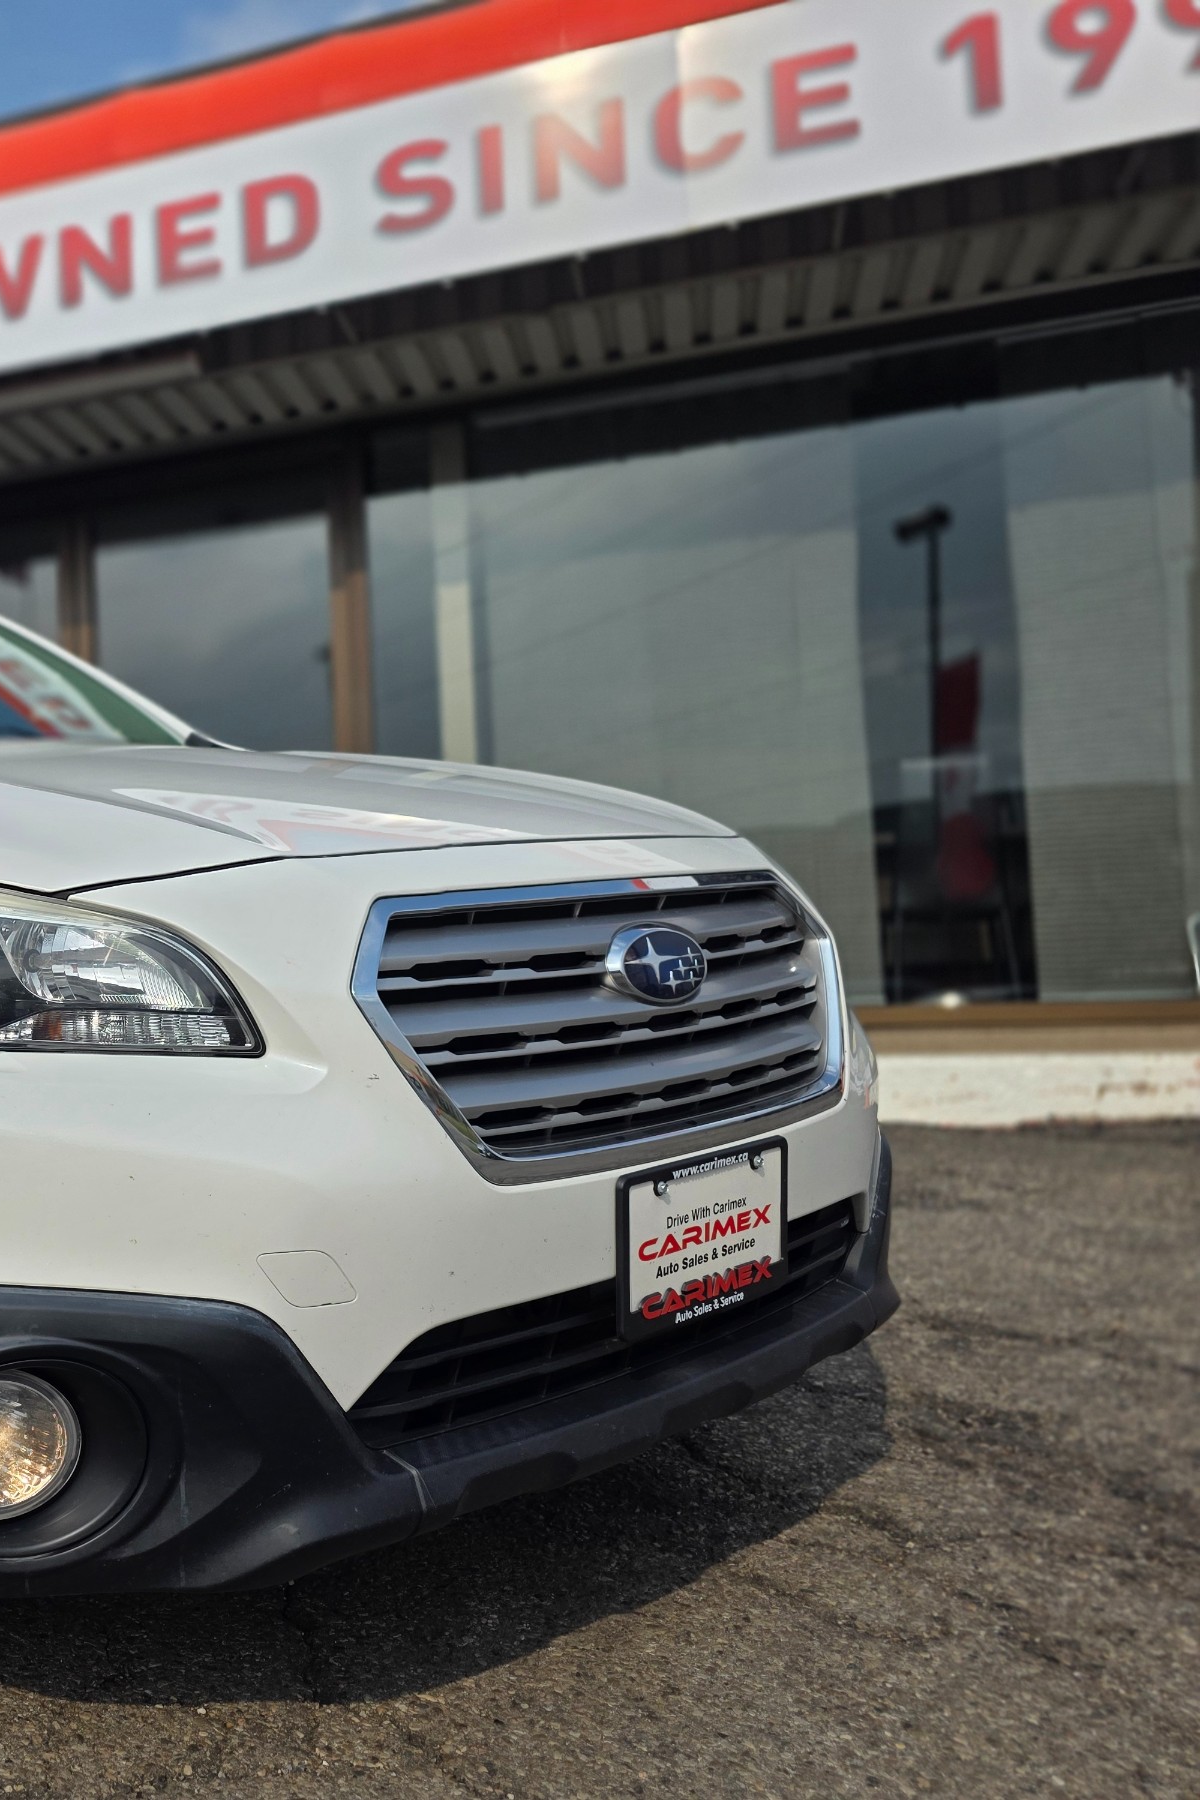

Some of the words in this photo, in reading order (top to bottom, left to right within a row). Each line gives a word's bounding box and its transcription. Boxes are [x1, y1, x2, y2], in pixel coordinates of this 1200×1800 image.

[375, 43, 862, 237] SINCE
[938, 0, 1200, 116] 19
[672, 1152, 749, 1180] www.carimex.ca
[638, 1204, 771, 1262] CARIMEX
[666, 1214, 690, 1229] Drive
[691, 1206, 711, 1221] With
[713, 1197, 747, 1215] Carimex
[655, 1264, 679, 1279] Auto
[682, 1252, 709, 1270] Sales
[711, 1247, 719, 1260] &
[721, 1237, 756, 1257] Service
[641, 1255, 773, 1320] CARIMEX
[675, 1310, 692, 1324] Auto
[693, 1302, 713, 1316] Sales
[713, 1299, 720, 1310] &
[720, 1291, 745, 1307] Service
